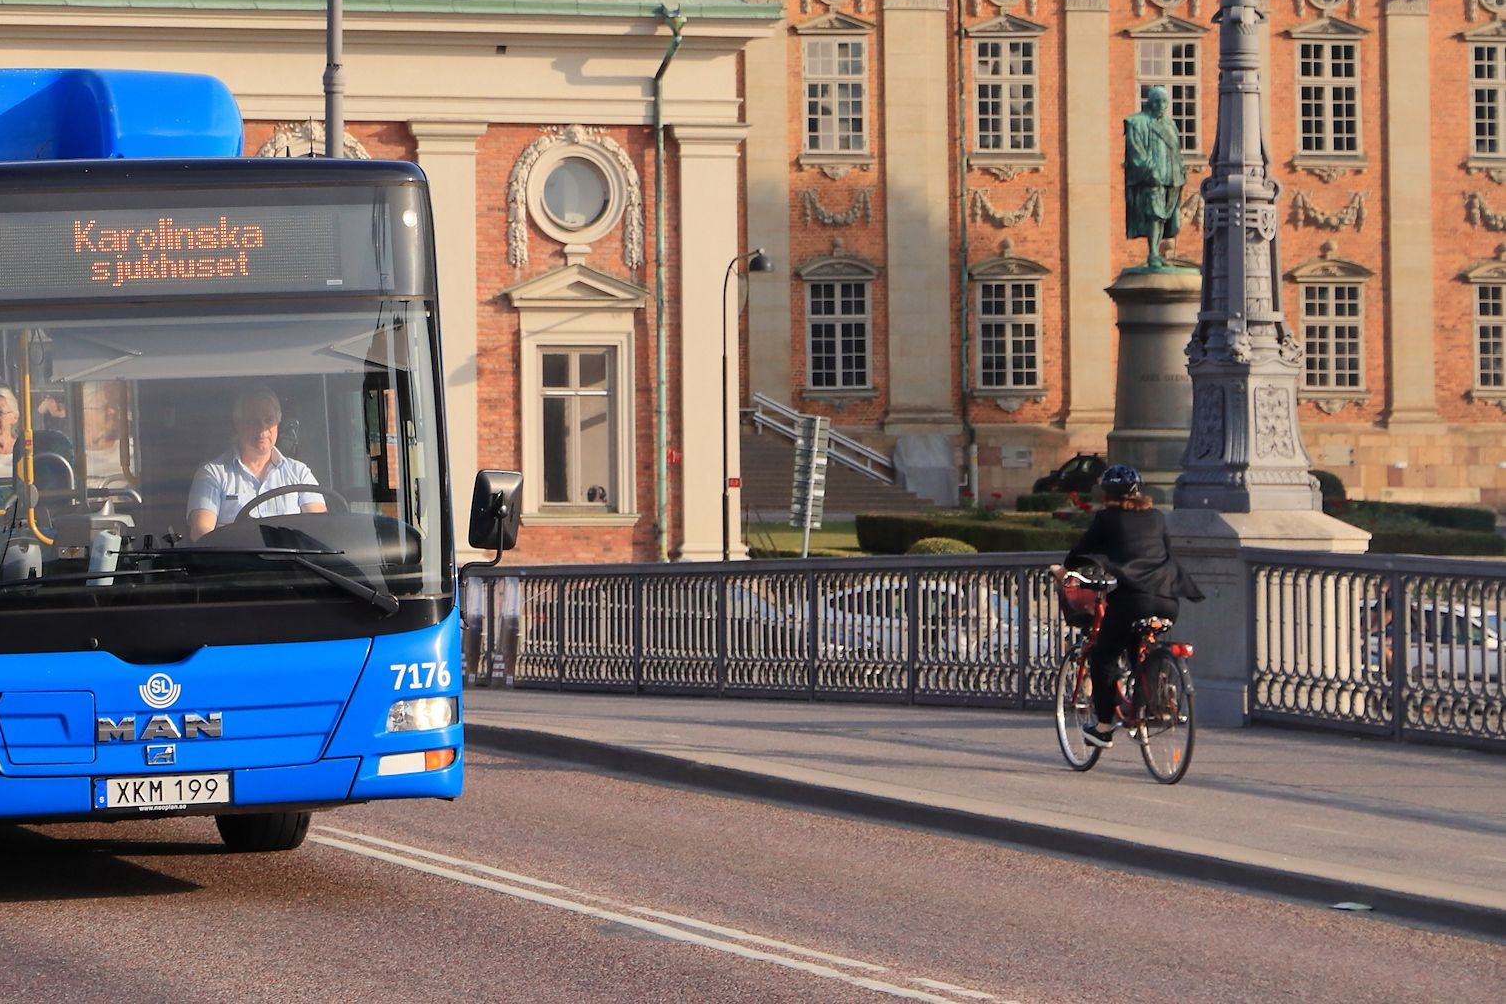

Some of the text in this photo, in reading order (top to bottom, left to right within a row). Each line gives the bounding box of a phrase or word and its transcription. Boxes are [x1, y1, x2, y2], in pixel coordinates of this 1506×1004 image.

[72, 216, 263, 253] Karolinska
[91, 251, 249, 287] sjukhuset
[151, 680, 169, 694] SL
[390, 661, 451, 690] 7176
[97, 711, 223, 742] MAN
[117, 780, 163, 804] XKM
[174, 778, 219, 801] 199
